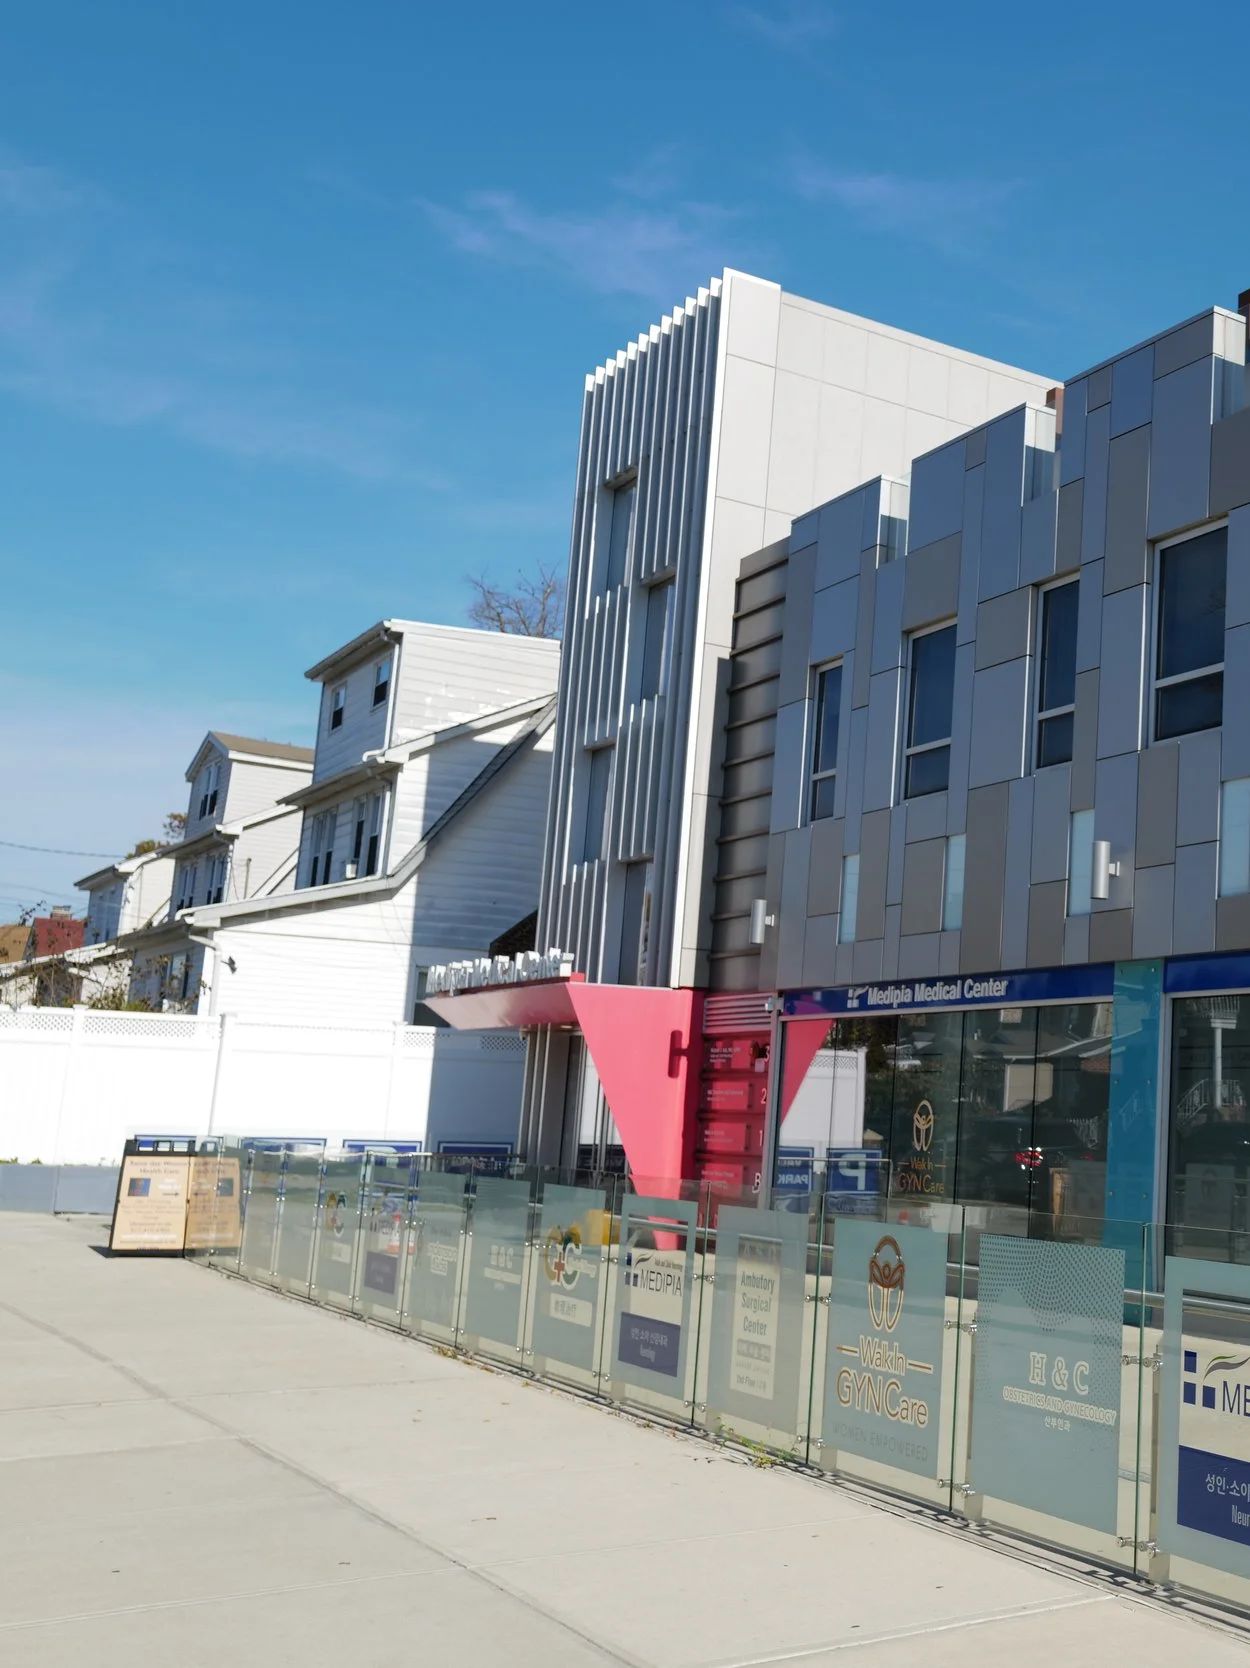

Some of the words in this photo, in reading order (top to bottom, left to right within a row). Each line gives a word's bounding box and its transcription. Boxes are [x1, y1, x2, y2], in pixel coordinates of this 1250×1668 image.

[867, 985, 913, 1008] Medipia
[914, 980, 962, 1002] Medical
[963, 978, 1008, 999] Center
[640, 1269, 682, 1297] MEDIPIA
[741, 1292, 771, 1314] Surgical
[743, 1315, 767, 1336] Center
[860, 1335, 891, 1371] Walk
[892, 1342, 906, 1376] In
[1029, 1351, 1047, 1386] H
[1052, 1356, 1069, 1391] &
[1073, 1361, 1089, 1395] C
[1003, 1386, 1045, 1409] OBSTETRICS
[1045, 1396, 1063, 1413] AND
[1063, 1400, 1117, 1426] GYNECOLOGY
